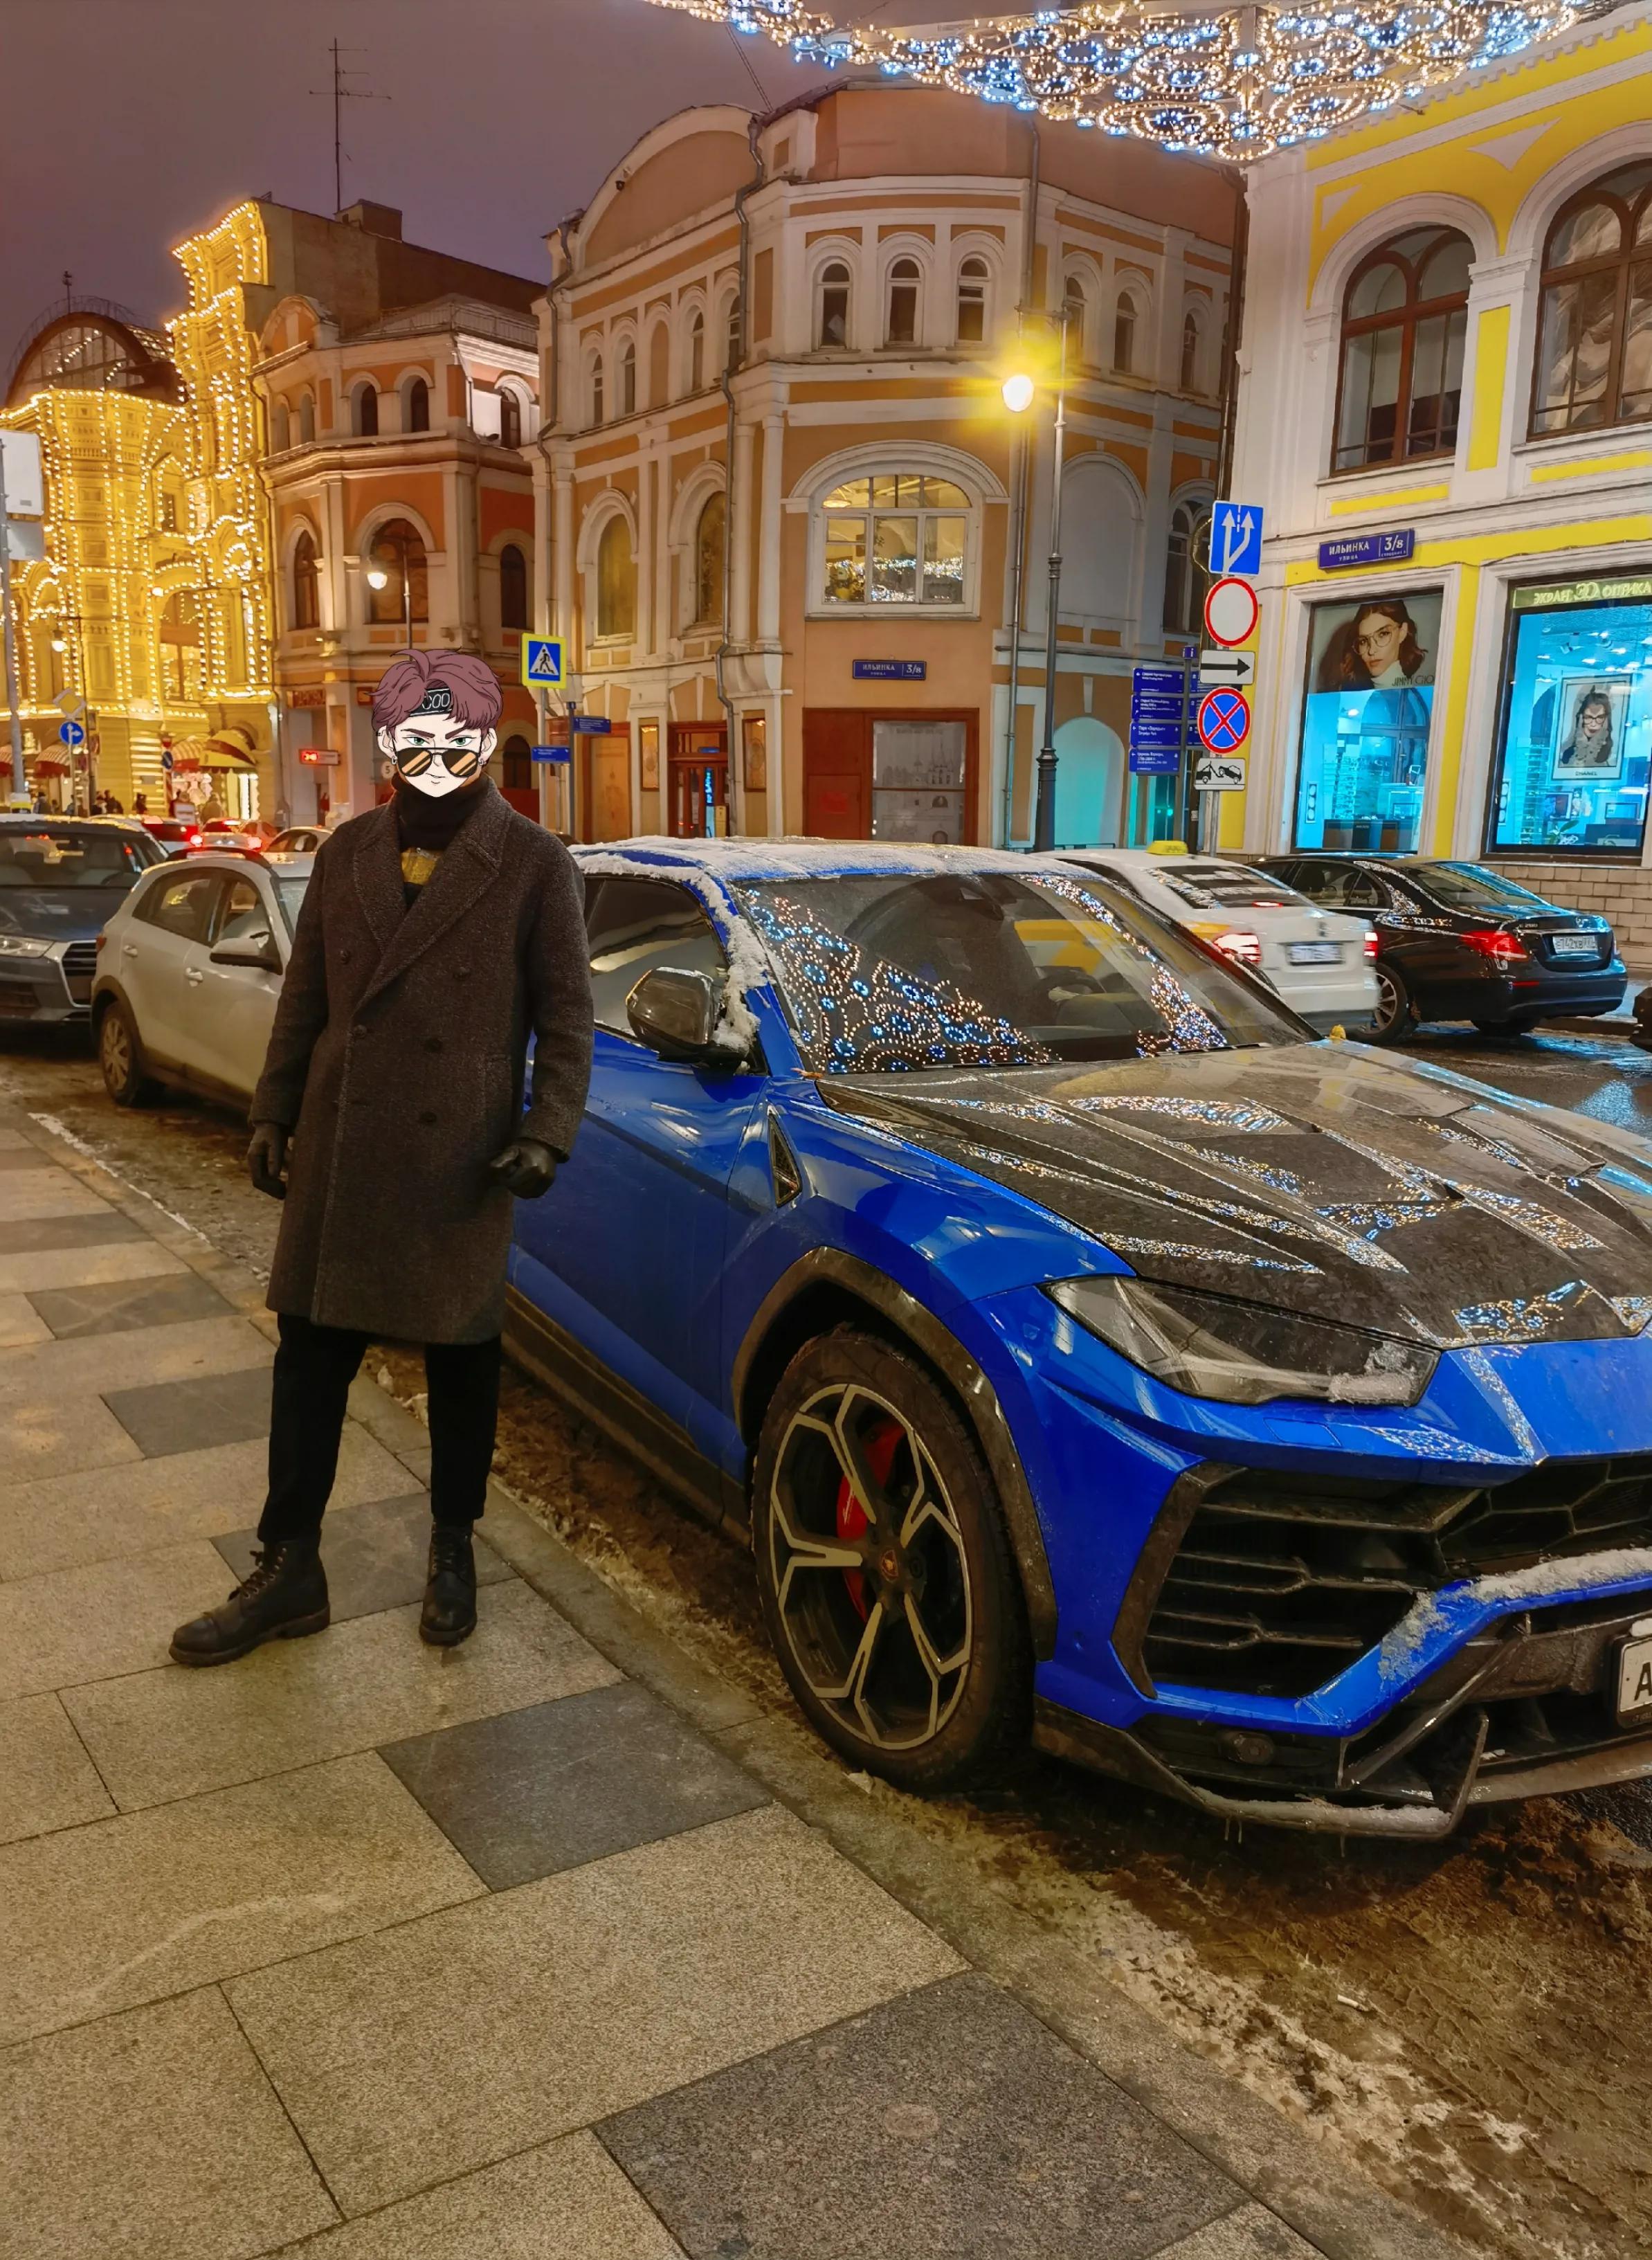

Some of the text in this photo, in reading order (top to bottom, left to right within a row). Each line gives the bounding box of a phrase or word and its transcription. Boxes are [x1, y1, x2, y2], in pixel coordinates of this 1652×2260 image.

[1329, 535, 1404, 555] ИЛЬИНКА 3/8
[1602, 581, 1652, 597] ОПТИКА
[906, 664, 922, 674] 3/8
[1392, 676, 1413, 687] JIMMY
